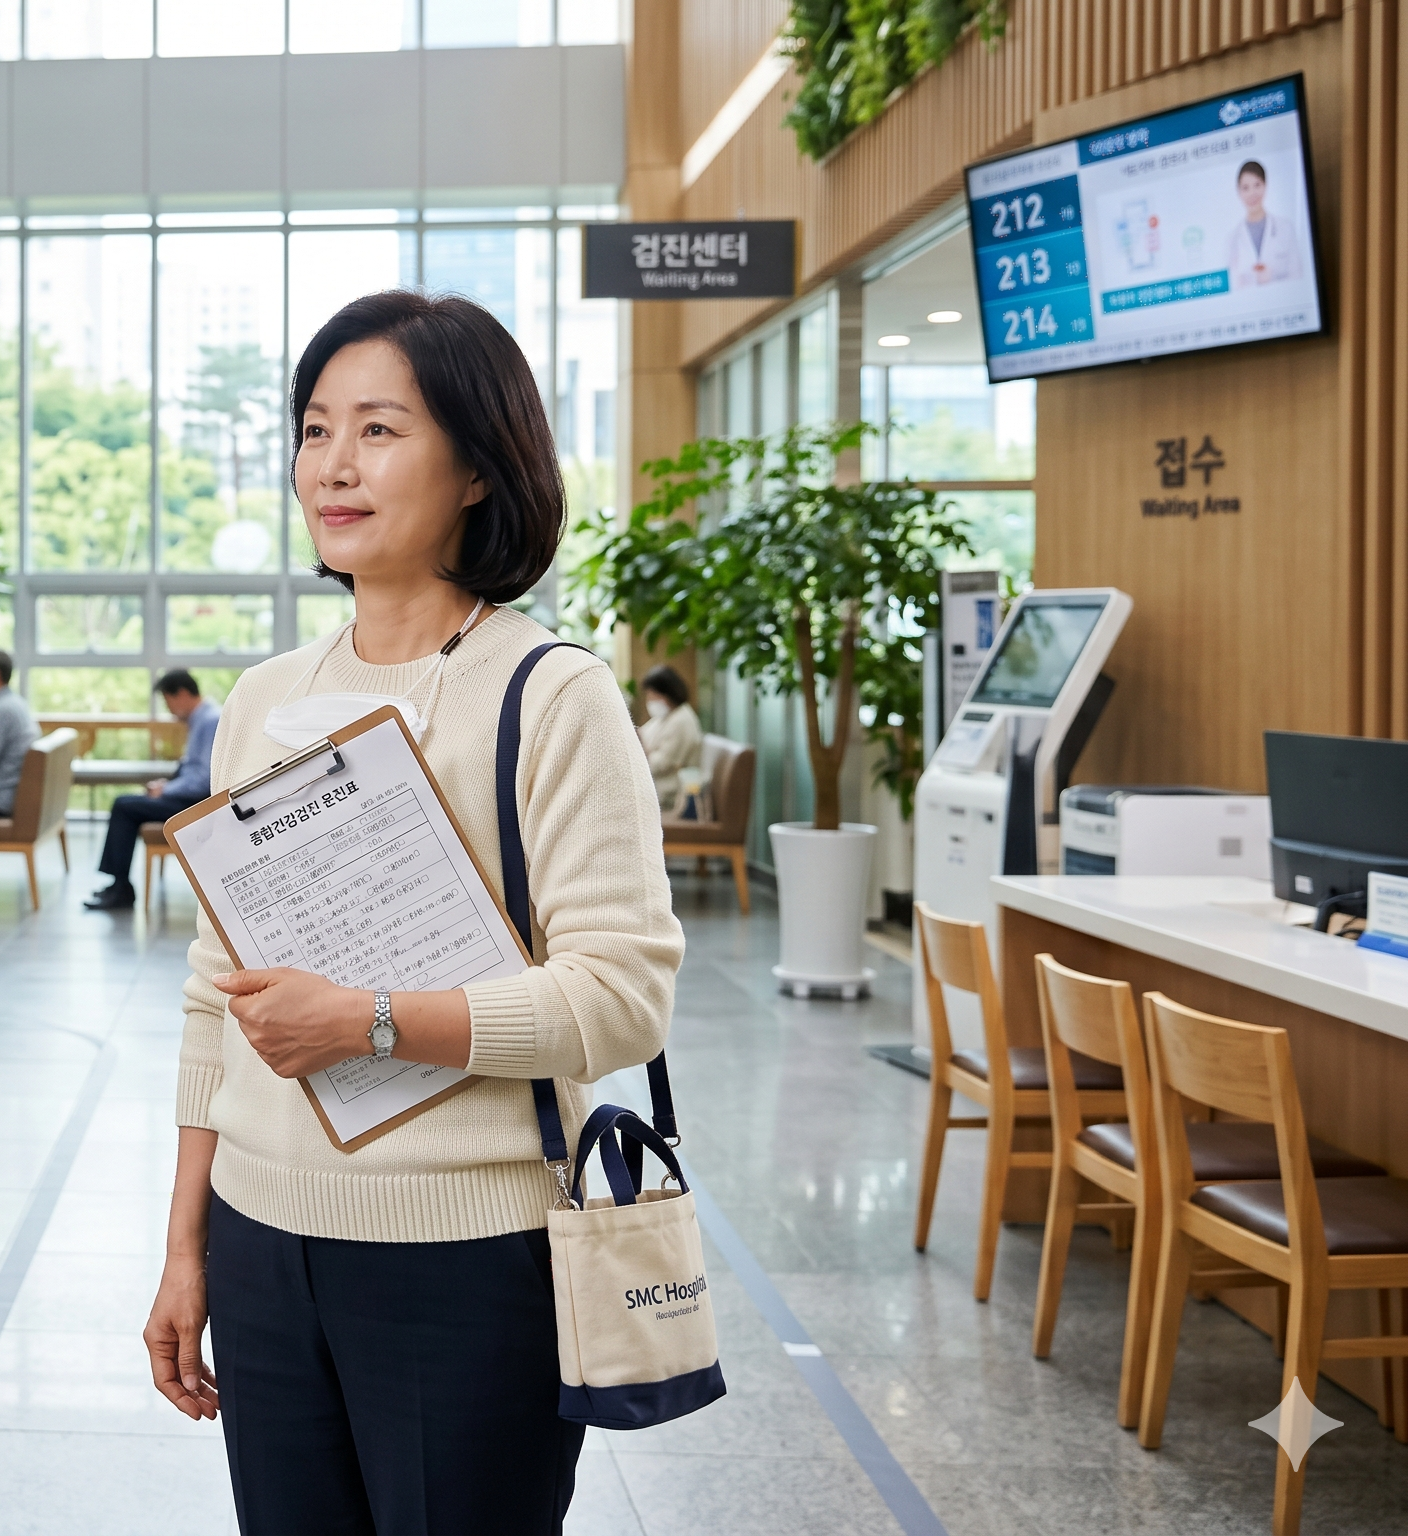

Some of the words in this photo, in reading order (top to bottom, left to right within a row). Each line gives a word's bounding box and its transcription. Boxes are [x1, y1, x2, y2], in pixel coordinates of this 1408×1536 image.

[990, 192, 1046, 238] 212
[631, 231, 748, 268] 검진센터
[996, 248, 1051, 291] 213
[1002, 304, 1058, 345] 214
[1155, 433, 1226, 489] 접수
[625, 1284, 663, 1310] SMC
